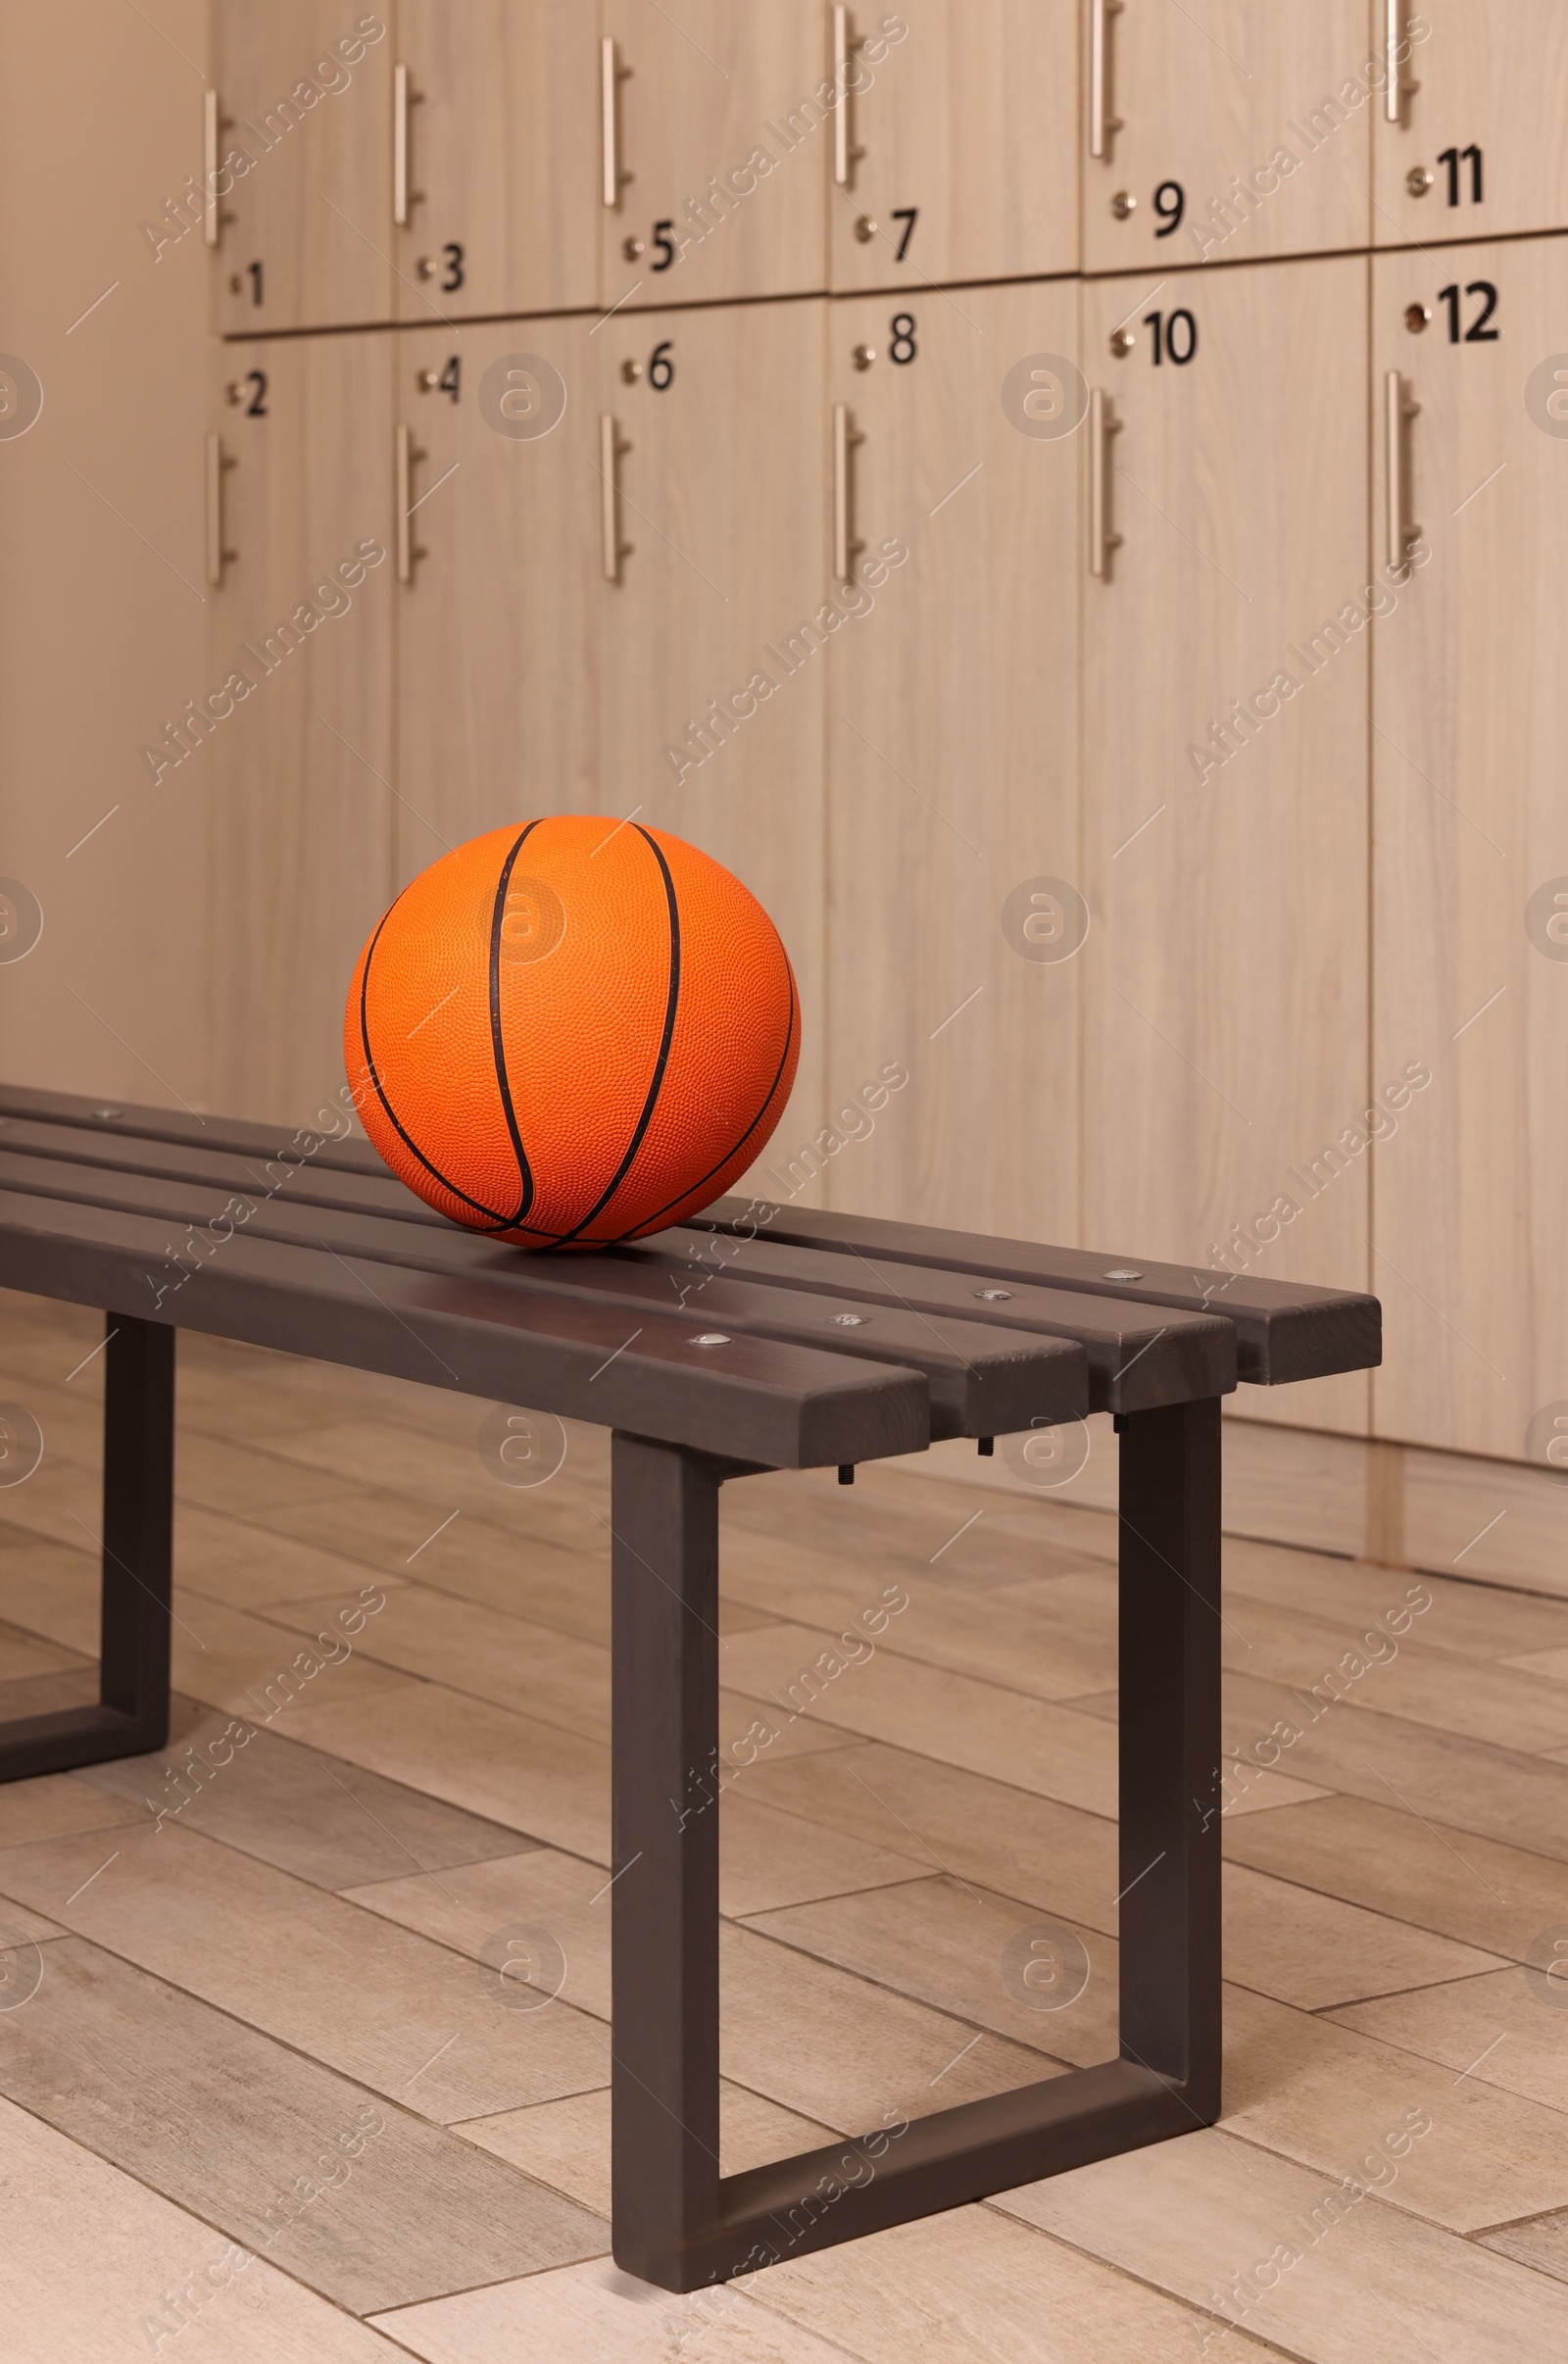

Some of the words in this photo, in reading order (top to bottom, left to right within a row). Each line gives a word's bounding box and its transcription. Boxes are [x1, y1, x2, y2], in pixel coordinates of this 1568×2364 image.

[1437, 143, 1484, 208] 11
[891, 208, 919, 263] 7
[1152, 180, 1186, 239] 9
[442, 242, 466, 293] 3
[651, 220, 675, 272] 5
[247, 261, 264, 307] 1
[1142, 308, 1199, 367] 10
[1437, 280, 1500, 345] 12
[889, 313, 917, 366] 8
[438, 356, 462, 404] 4
[648, 341, 674, 392] 6
[246, 369, 269, 418] 2
